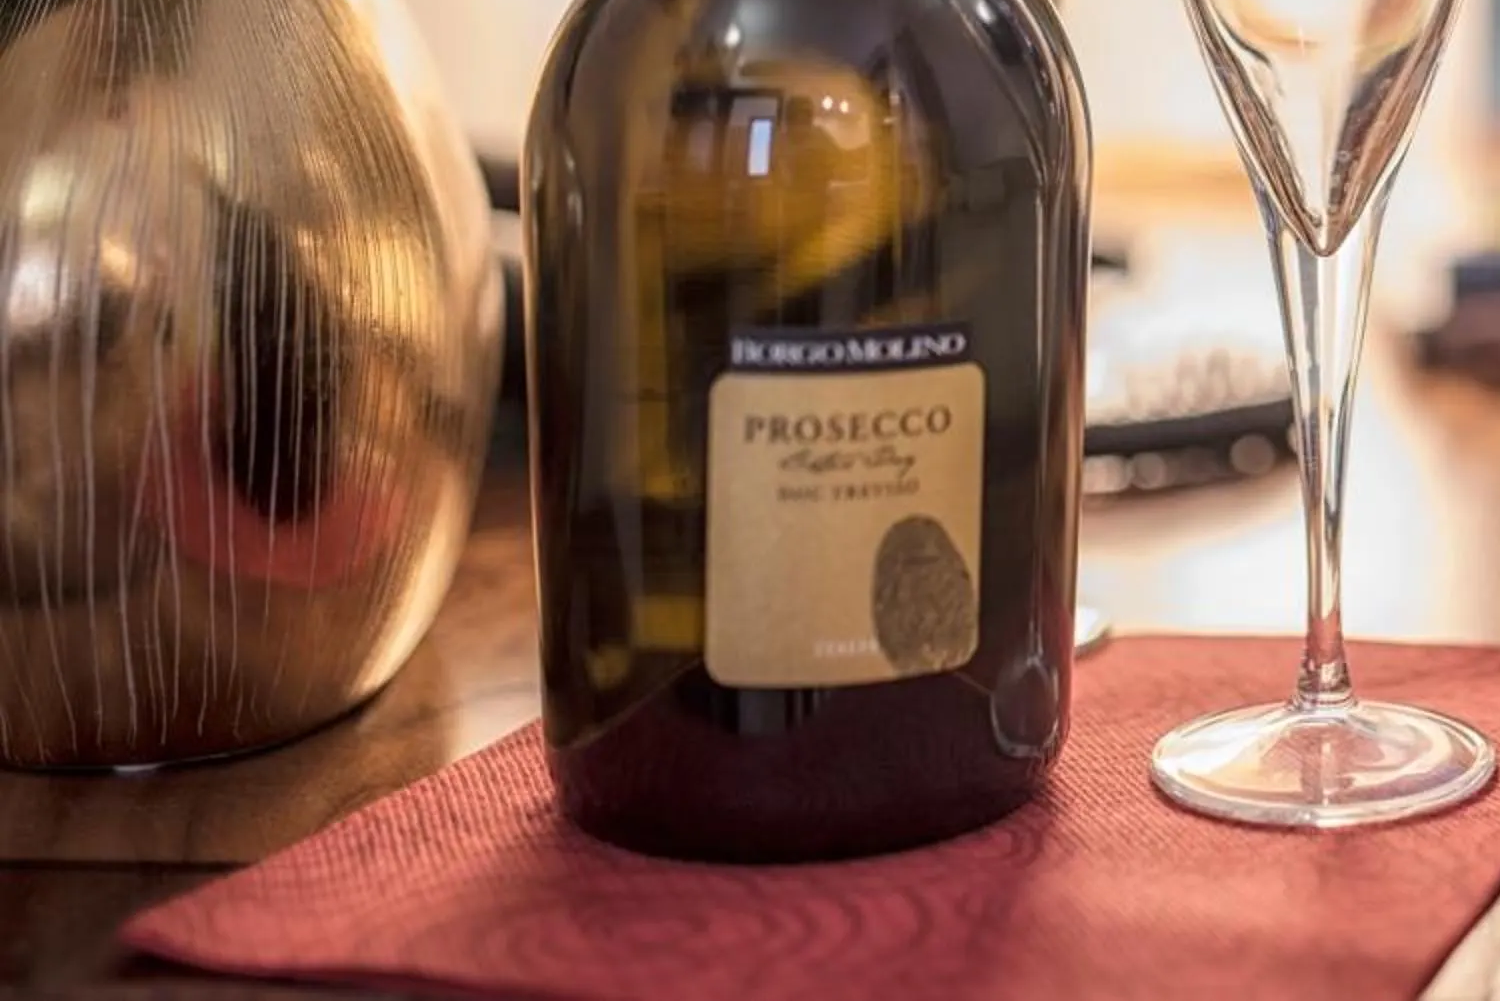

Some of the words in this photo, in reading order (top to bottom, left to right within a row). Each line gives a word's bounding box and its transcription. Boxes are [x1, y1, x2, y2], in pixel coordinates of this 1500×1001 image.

[731, 337, 845, 366] BORGO
[846, 333, 967, 363] MOLINO
[744, 404, 953, 443] PROSECCO
